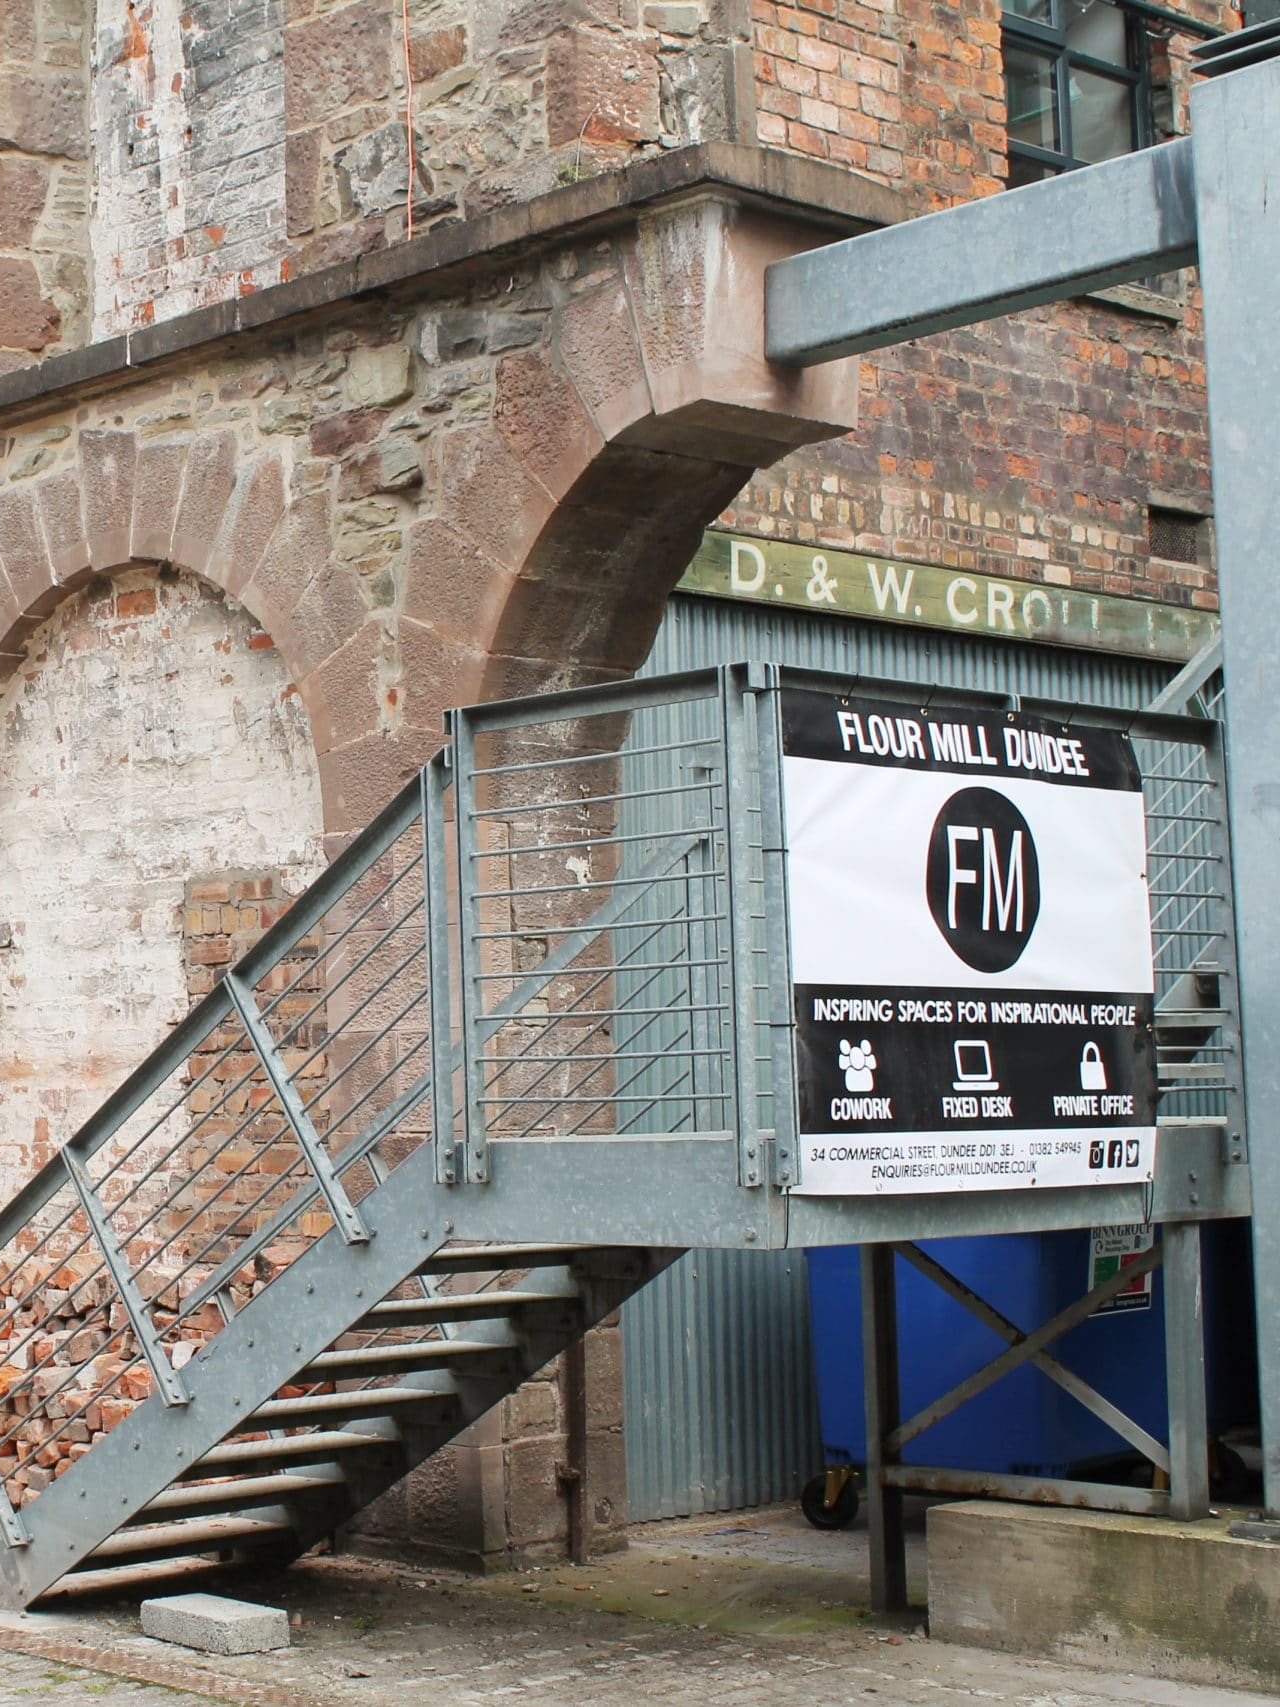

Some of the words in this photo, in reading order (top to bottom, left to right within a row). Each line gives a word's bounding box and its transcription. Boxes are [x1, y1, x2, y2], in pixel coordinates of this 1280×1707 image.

[729, 541, 783, 597] D.
[806, 555, 838, 604] &
[867, 564, 922, 617] W.
[836, 711, 926, 760] FLOUR
[928, 722, 997, 766] MILL
[1003, 727, 1090, 777] DUNDEE
[946, 825, 1024, 932] FM
[813, 998, 893, 1023] INSPIRING
[897, 1000, 953, 1023] SPACES
[957, 1001, 988, 1024] FOR
[991, 1002, 1088, 1025] INSPIRATIONAL
[1090, 1004, 1136, 1027] PEOPLE
[830, 1097, 893, 1120] COWORK
[942, 1096, 978, 1118] FIXED
[982, 1096, 1013, 1118] DESK
[1053, 1095, 1098, 1117] PRIVATE
[1101, 1095, 1134, 1116] OFFICE
[811, 1148, 826, 1161] 34
[828, 1147, 905, 1160] COMMERCIAL
[941, 1144, 977, 1158] DUNDEE
[979, 1144, 996, 1158] DD1
[999, 1143, 1015, 1157] 3EJ
[1029, 1142, 1052, 1156] 01382
[1054, 1141, 1081, 1155] 549945
[871, 1161, 1037, 1178] ENQUIRIES@FLOURMILLDUNDEE.CO.UK
